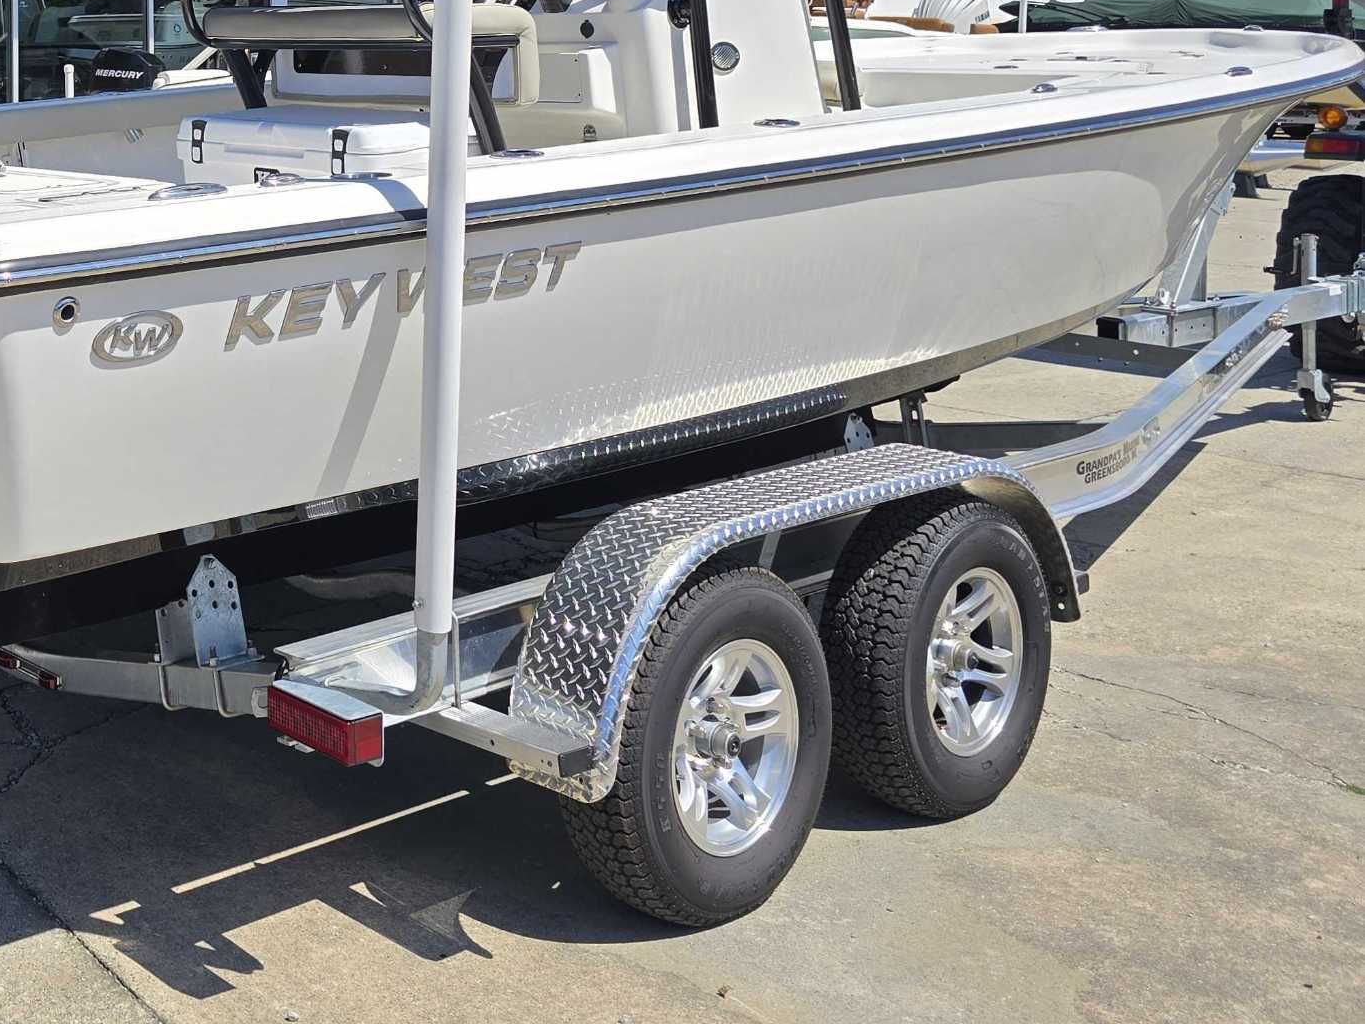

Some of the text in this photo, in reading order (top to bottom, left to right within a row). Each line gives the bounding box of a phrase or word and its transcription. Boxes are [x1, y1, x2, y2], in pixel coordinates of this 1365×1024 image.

[95, 68, 144, 79] MERCURY
[224, 272, 386, 352] KEY
[109, 323, 170, 356] KW
